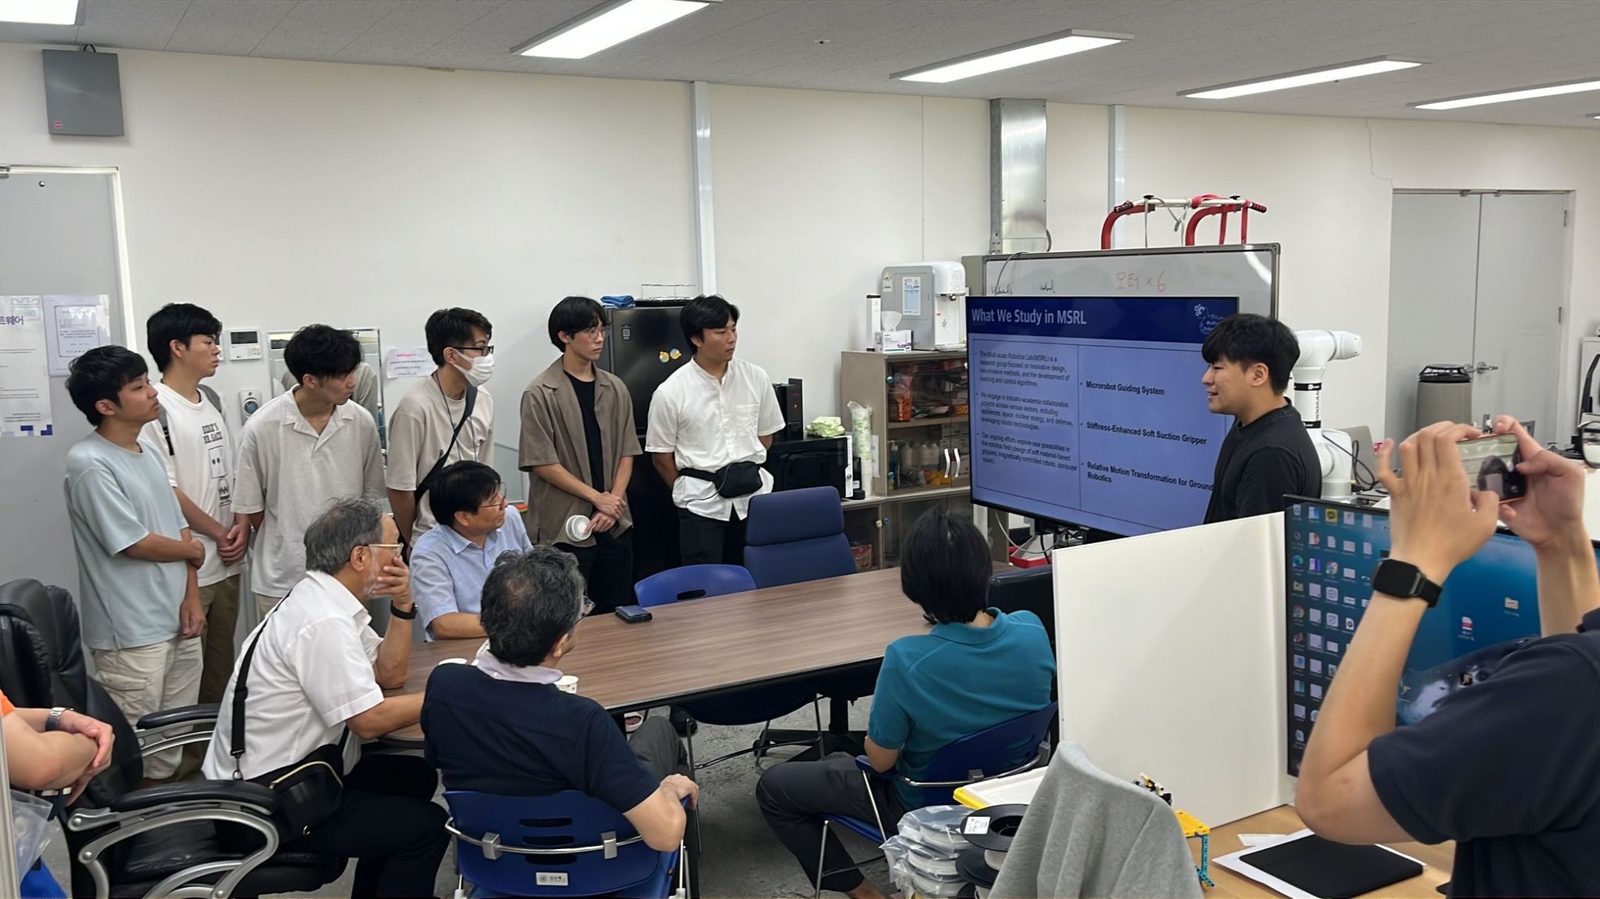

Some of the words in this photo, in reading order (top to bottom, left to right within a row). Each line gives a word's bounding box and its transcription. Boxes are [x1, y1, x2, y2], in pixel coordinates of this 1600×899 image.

[971, 308, 995, 322] What
[997, 308, 1012, 323] We
[1014, 308, 1042, 326] Study
[1044, 309, 1054, 324] in
[1057, 310, 1087, 325] MSRL
[1086, 380, 1117, 391] Microrobot
[1117, 384, 1140, 395] Guiding
[1142, 385, 1165, 396] System
[1086, 421, 1141, 436] Stiffness-Enhanced
[1142, 428, 1155, 438] Soft
[1156, 431, 1180, 442] Suction
[1181, 434, 1207, 446] Gripper
[1087, 461, 1109, 473] Relative
[1110, 465, 1130, 477] Motion
[1131, 469, 1177, 485] Transformation
[1178, 478, 1187, 486] for
[1087, 471, 1112, 483] Robotics
